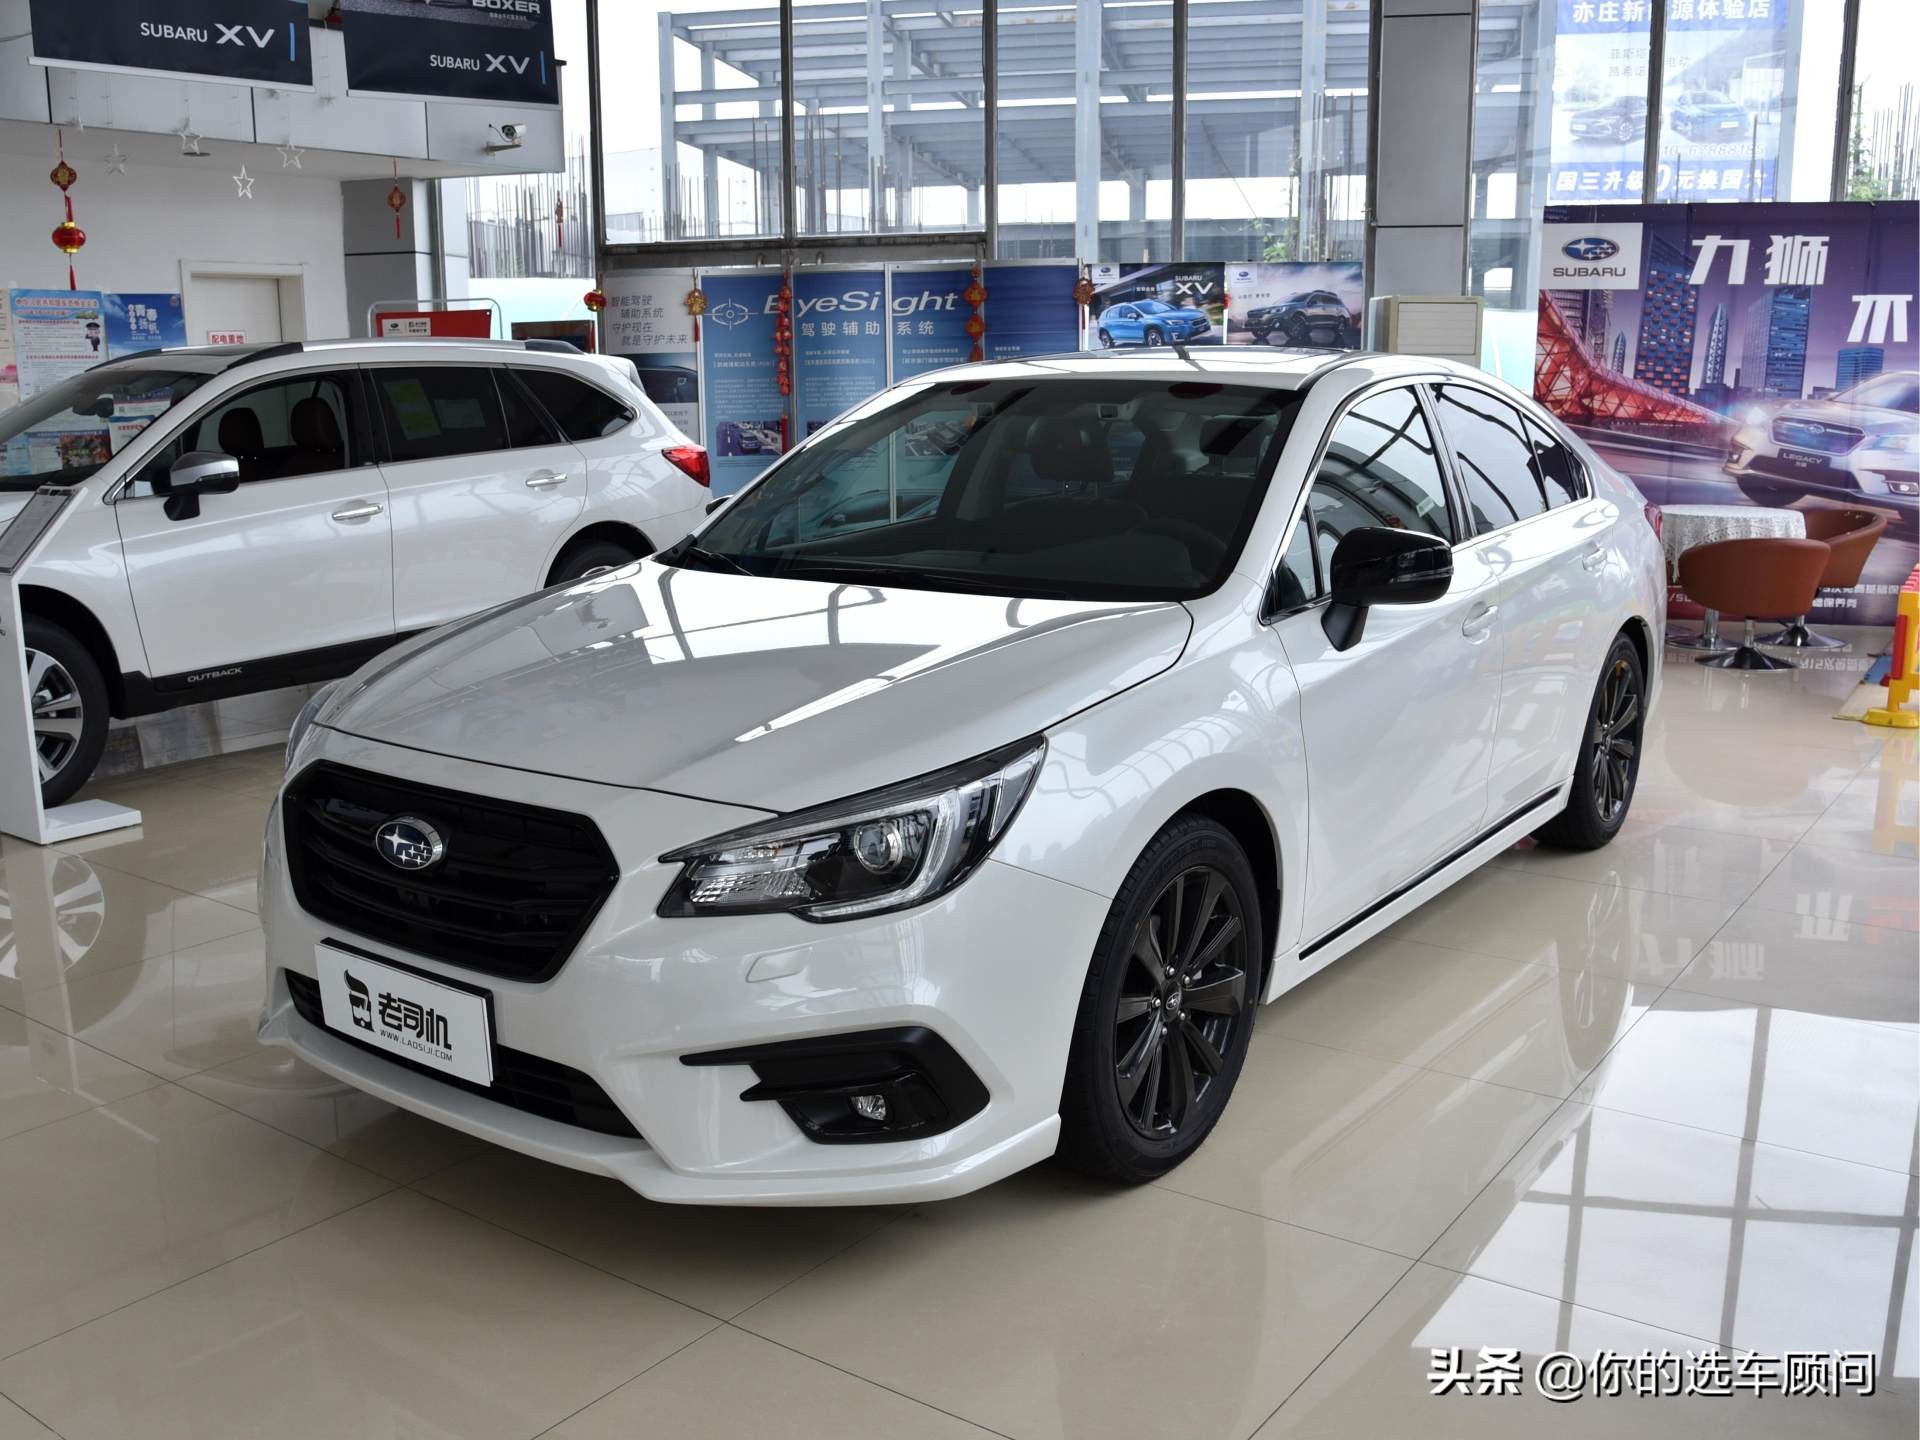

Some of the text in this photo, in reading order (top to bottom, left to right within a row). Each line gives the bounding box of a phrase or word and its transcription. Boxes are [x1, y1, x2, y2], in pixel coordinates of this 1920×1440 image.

[472, 0, 540, 14] BOXER
[1572, 0, 1769, 23] 亦庄新源体验店
[140, 22, 275, 48] SUBARU XV
[429, 53, 530, 75] SUBARU XV
[1688, 234, 1830, 286] 力狮
[1552, 267, 1627, 278] SUBARU
[1174, 282, 1214, 295] XV
[611, 295, 653, 307] 智能驾驶
[763, 290, 959, 318] EyeSight
[620, 308, 664, 320] 辅助系统
[612, 322, 654, 334] 守护现在
[801, 320, 935, 337] 驾驶辅助系统
[622, 335, 689, 347] 就是守护未来
[1783, 452, 1823, 465] LEGACY
[188, 667, 242, 682] OUTBACK
[378, 991, 453, 1051] 老司机
[380, 1028, 453, 1063] WWW.LAOSIJI.COM
